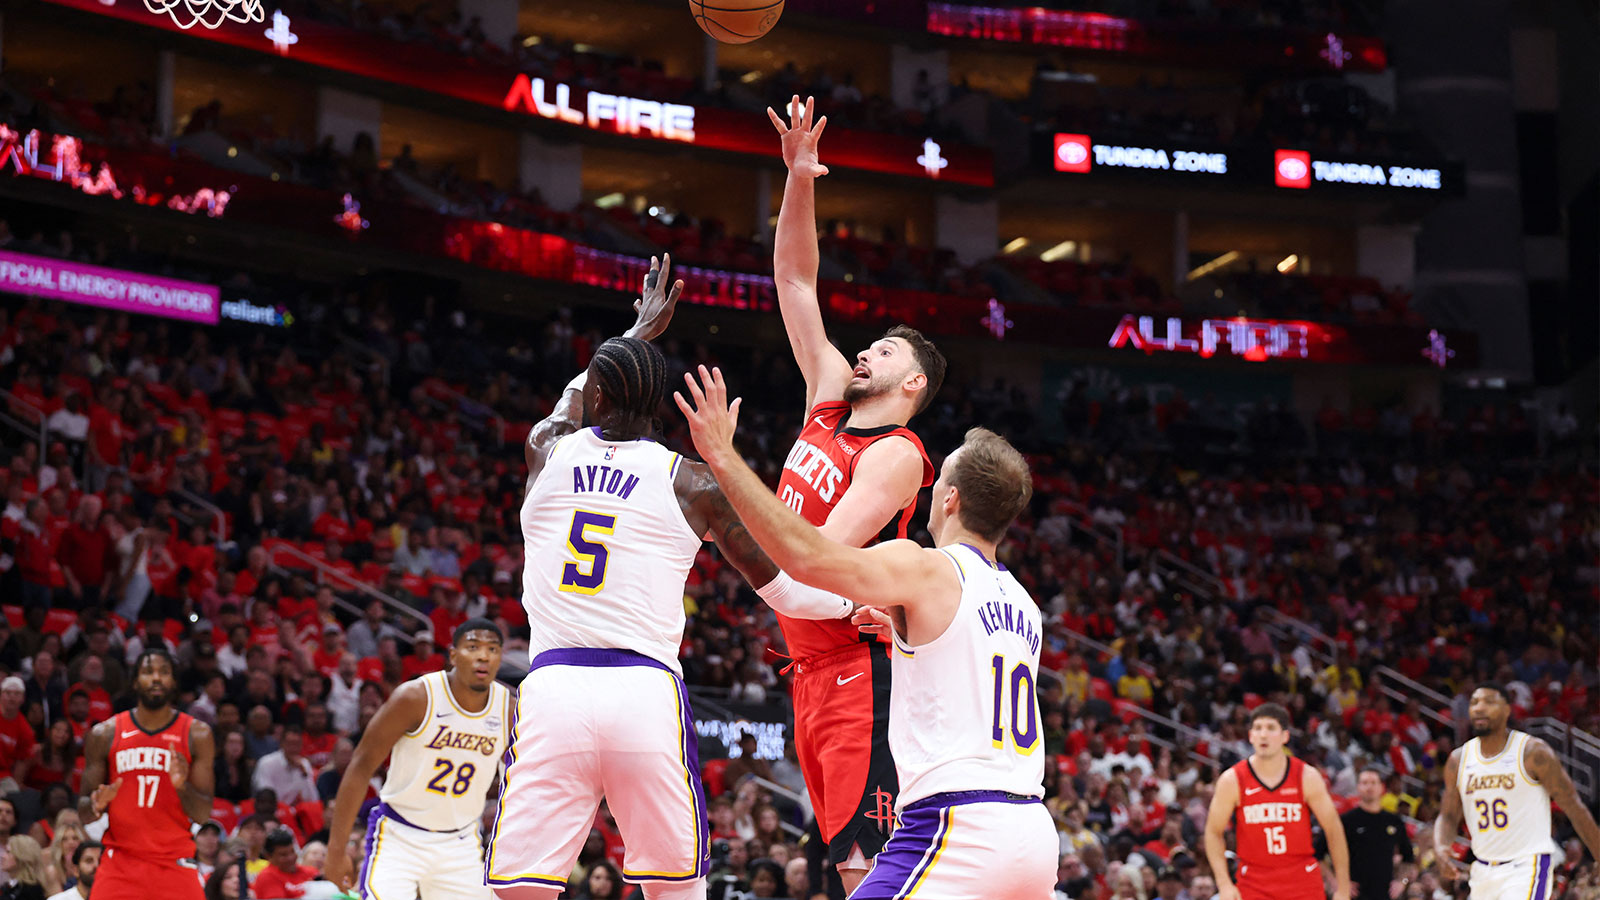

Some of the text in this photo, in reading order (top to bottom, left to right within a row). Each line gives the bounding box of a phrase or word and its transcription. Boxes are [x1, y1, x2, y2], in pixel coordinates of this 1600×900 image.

[504, 73, 695, 142] ALL FIRE
[1092, 144, 1227, 173] TUNDRA ZONE
[1312, 161, 1441, 189] TUNDRA ZONE
[0, 260, 213, 314] FICIAL ENERGY PROVIDER
[221, 299, 275, 325] reliant
[573, 465, 640, 500] AYTON
[783, 439, 843, 503] OCKETS
[558, 509, 617, 596] 5
[978, 601, 1040, 656] KENNARD
[991, 652, 1040, 756] 10
[424, 725, 497, 756] LAKERS
[116, 746, 171, 774] ROCKET
[137, 775, 160, 808] 17
[425, 757, 476, 798] 28
[1466, 773, 1515, 794] LAKERS
[1243, 802, 1302, 824] ROCKETS
[1475, 797, 1508, 832] 36
[1264, 826, 1287, 855] 15
